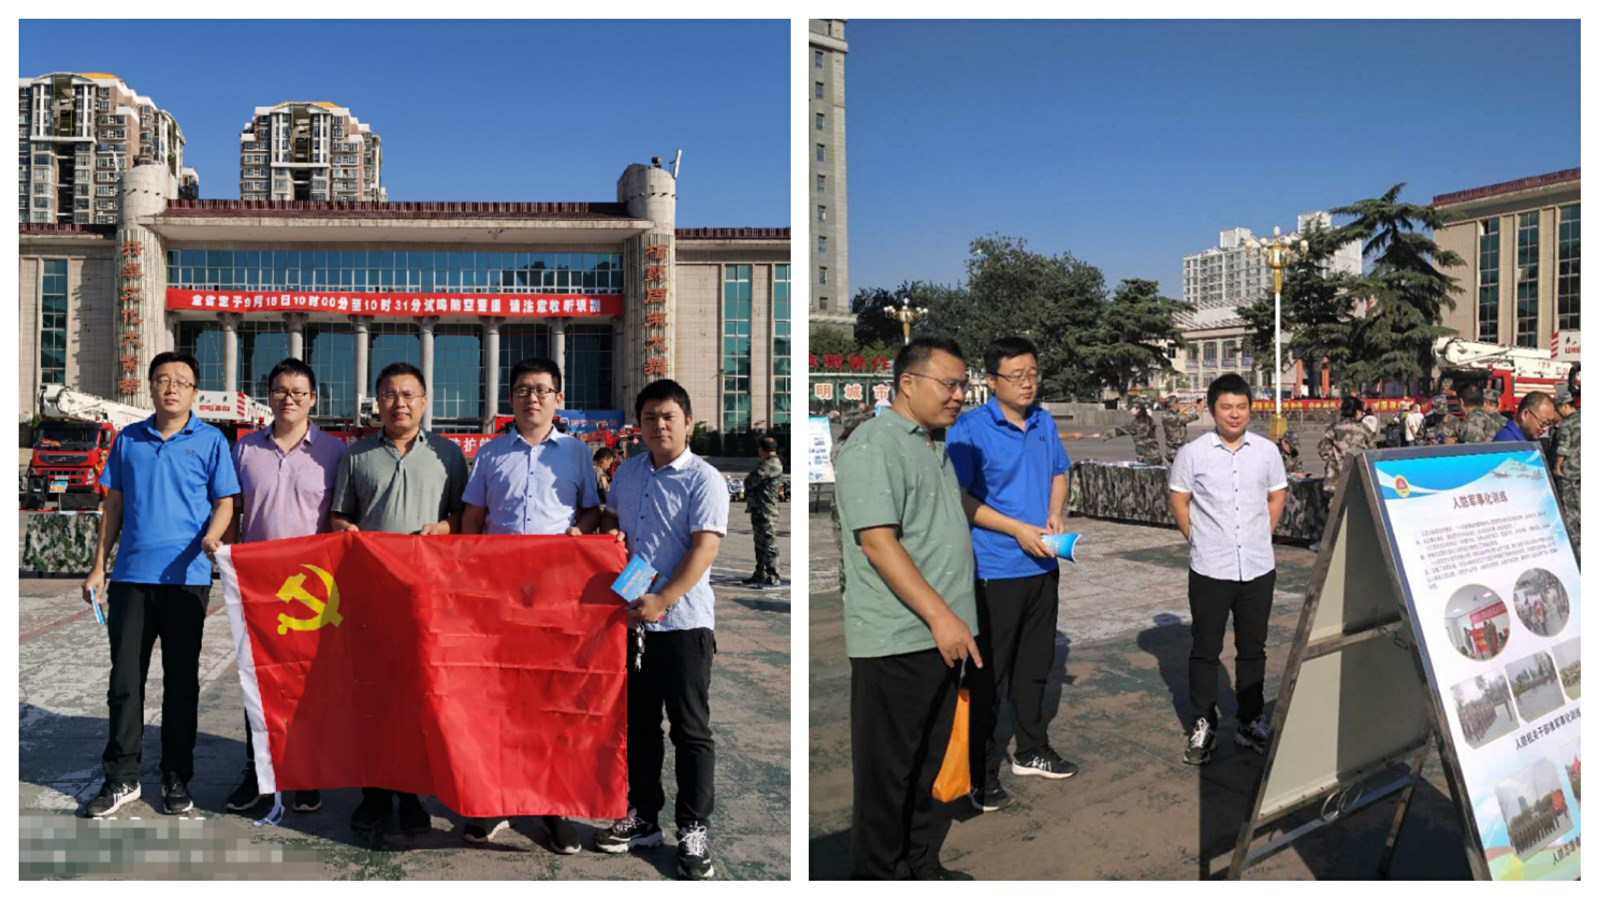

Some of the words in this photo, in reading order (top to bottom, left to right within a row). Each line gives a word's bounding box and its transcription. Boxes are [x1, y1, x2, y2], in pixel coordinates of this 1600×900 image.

[1453, 491, 1508, 510] 人防军事化训练
